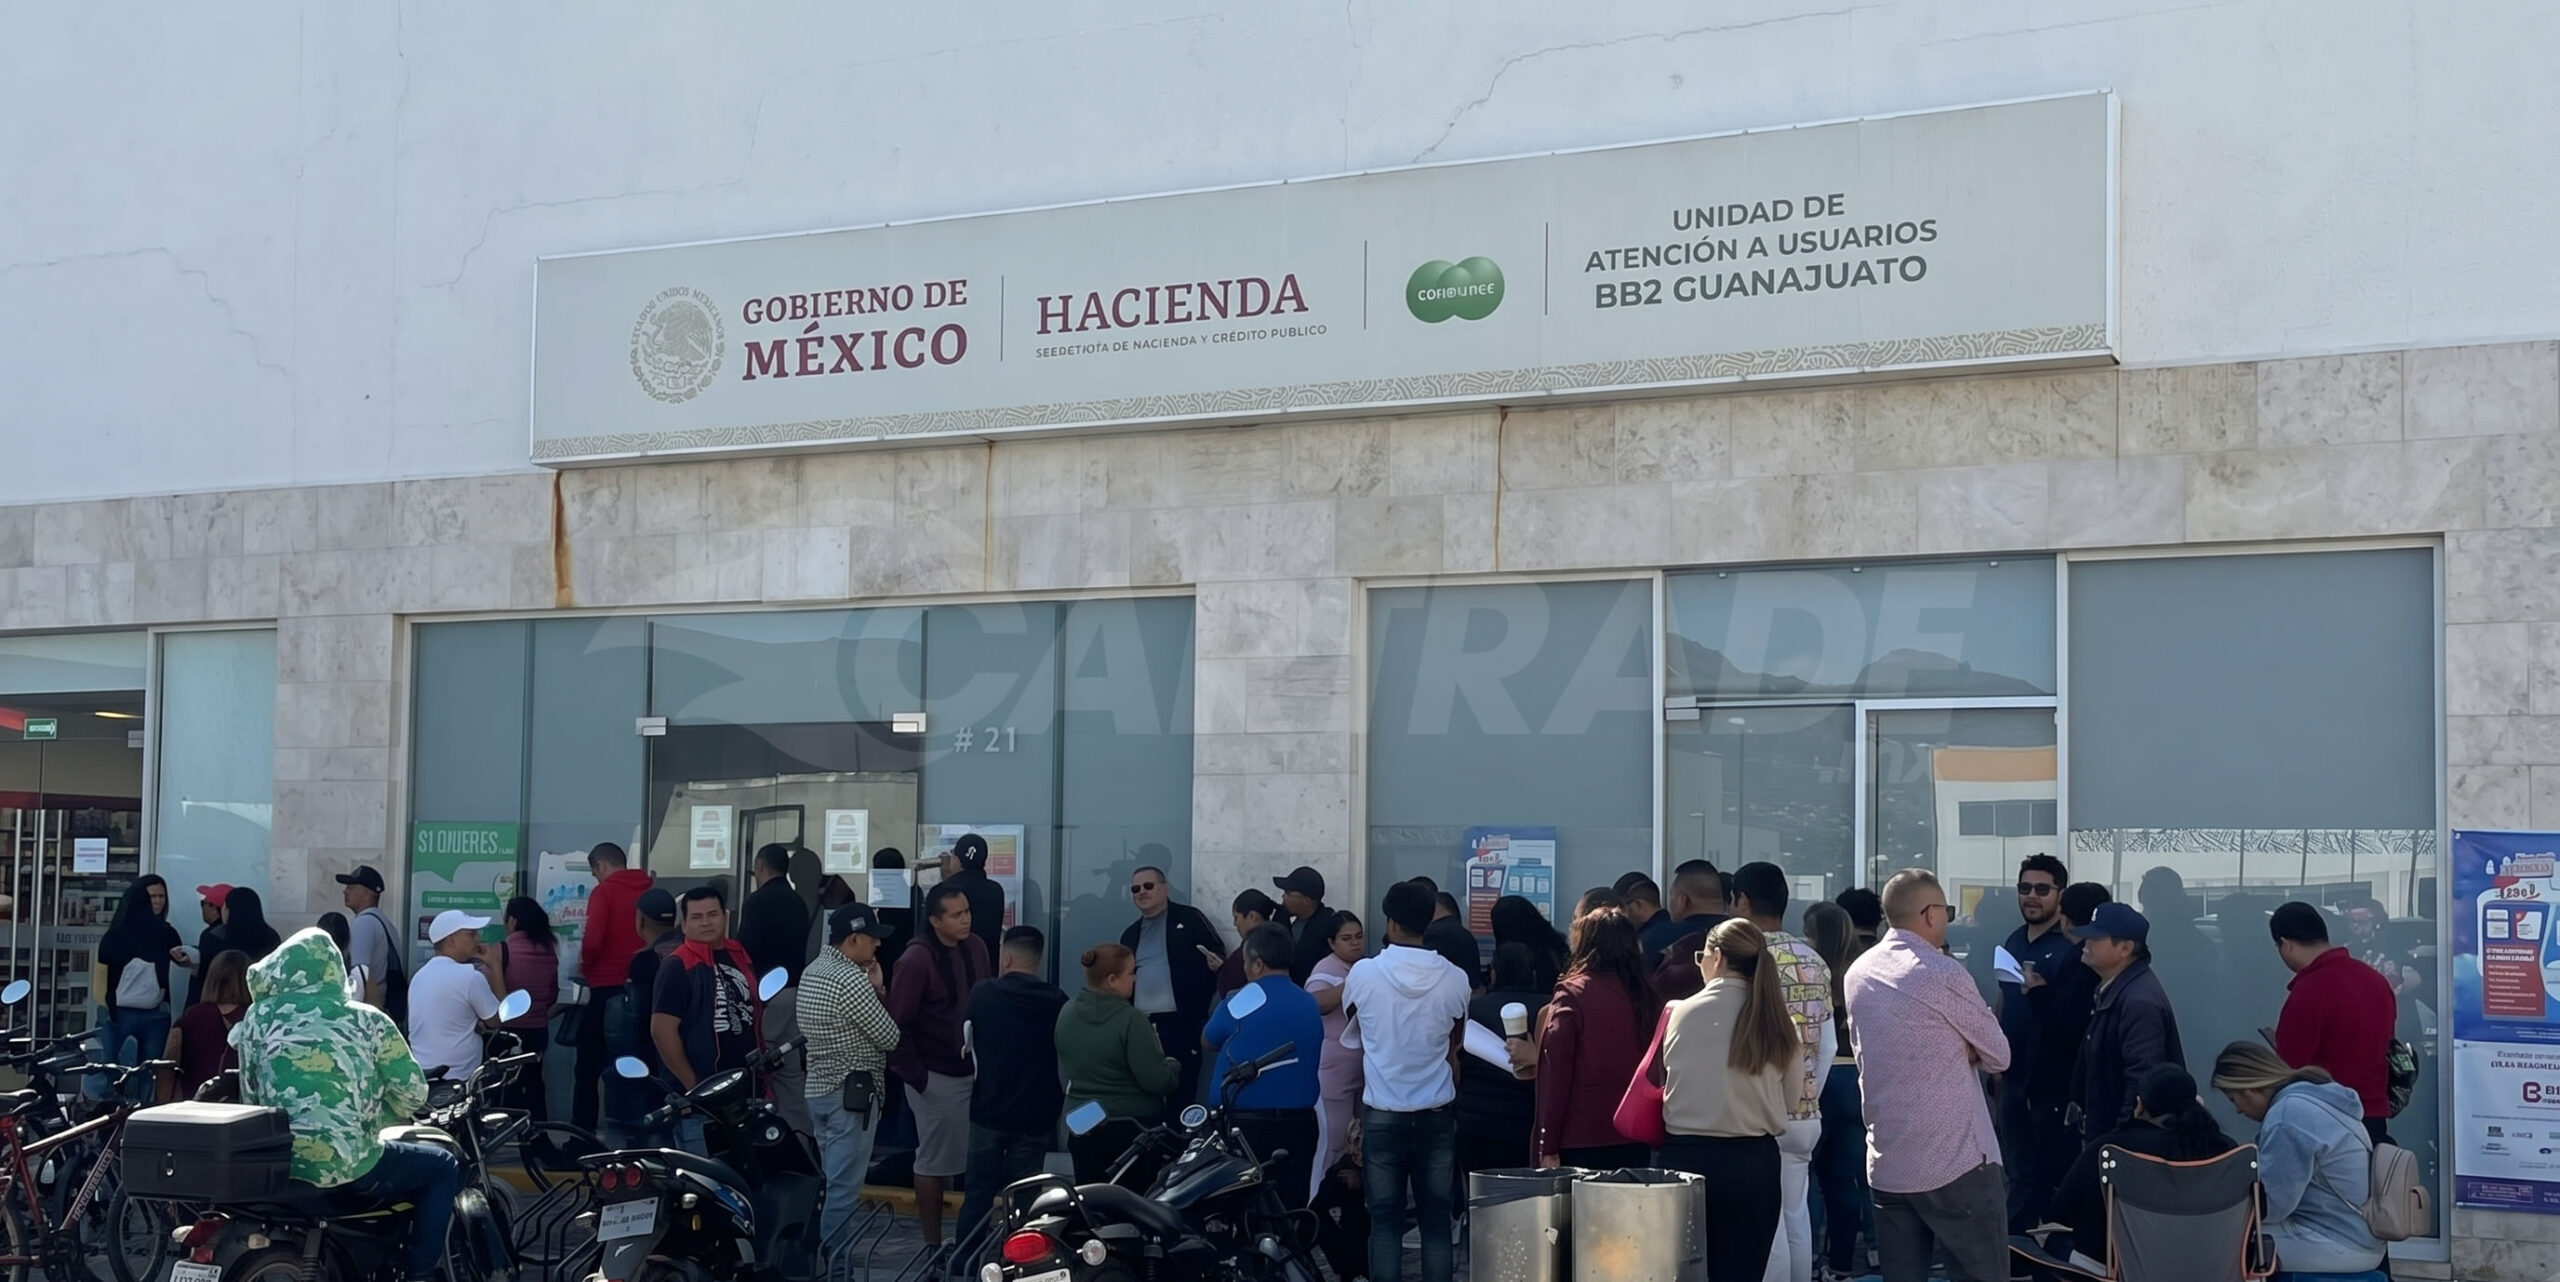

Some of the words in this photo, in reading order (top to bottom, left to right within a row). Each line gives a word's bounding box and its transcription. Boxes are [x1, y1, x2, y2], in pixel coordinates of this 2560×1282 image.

[1673, 199, 1793, 231] UNIDAD
[1804, 193, 1845, 217] DE
[1585, 236, 1738, 272] ATENCIÓN
[1747, 236, 1769, 259] A
[1778, 219, 1938, 256] USUARIOS
[742, 284, 914, 325] GOBIERNO
[923, 279, 968, 310] DE
[1036, 273, 1309, 335] HACIENDA
[1595, 279, 1662, 309] BB2
[1673, 254, 1927, 302] GUANAJUATO
[742, 321, 968, 381] MÉXICO
[1113, 340, 1129, 352] DE
[1200, 335, 1208, 344] Y
[1271, 324, 1327, 339] PUBLICO
[954, 726, 974, 752] #
[984, 726, 1015, 752] 21
